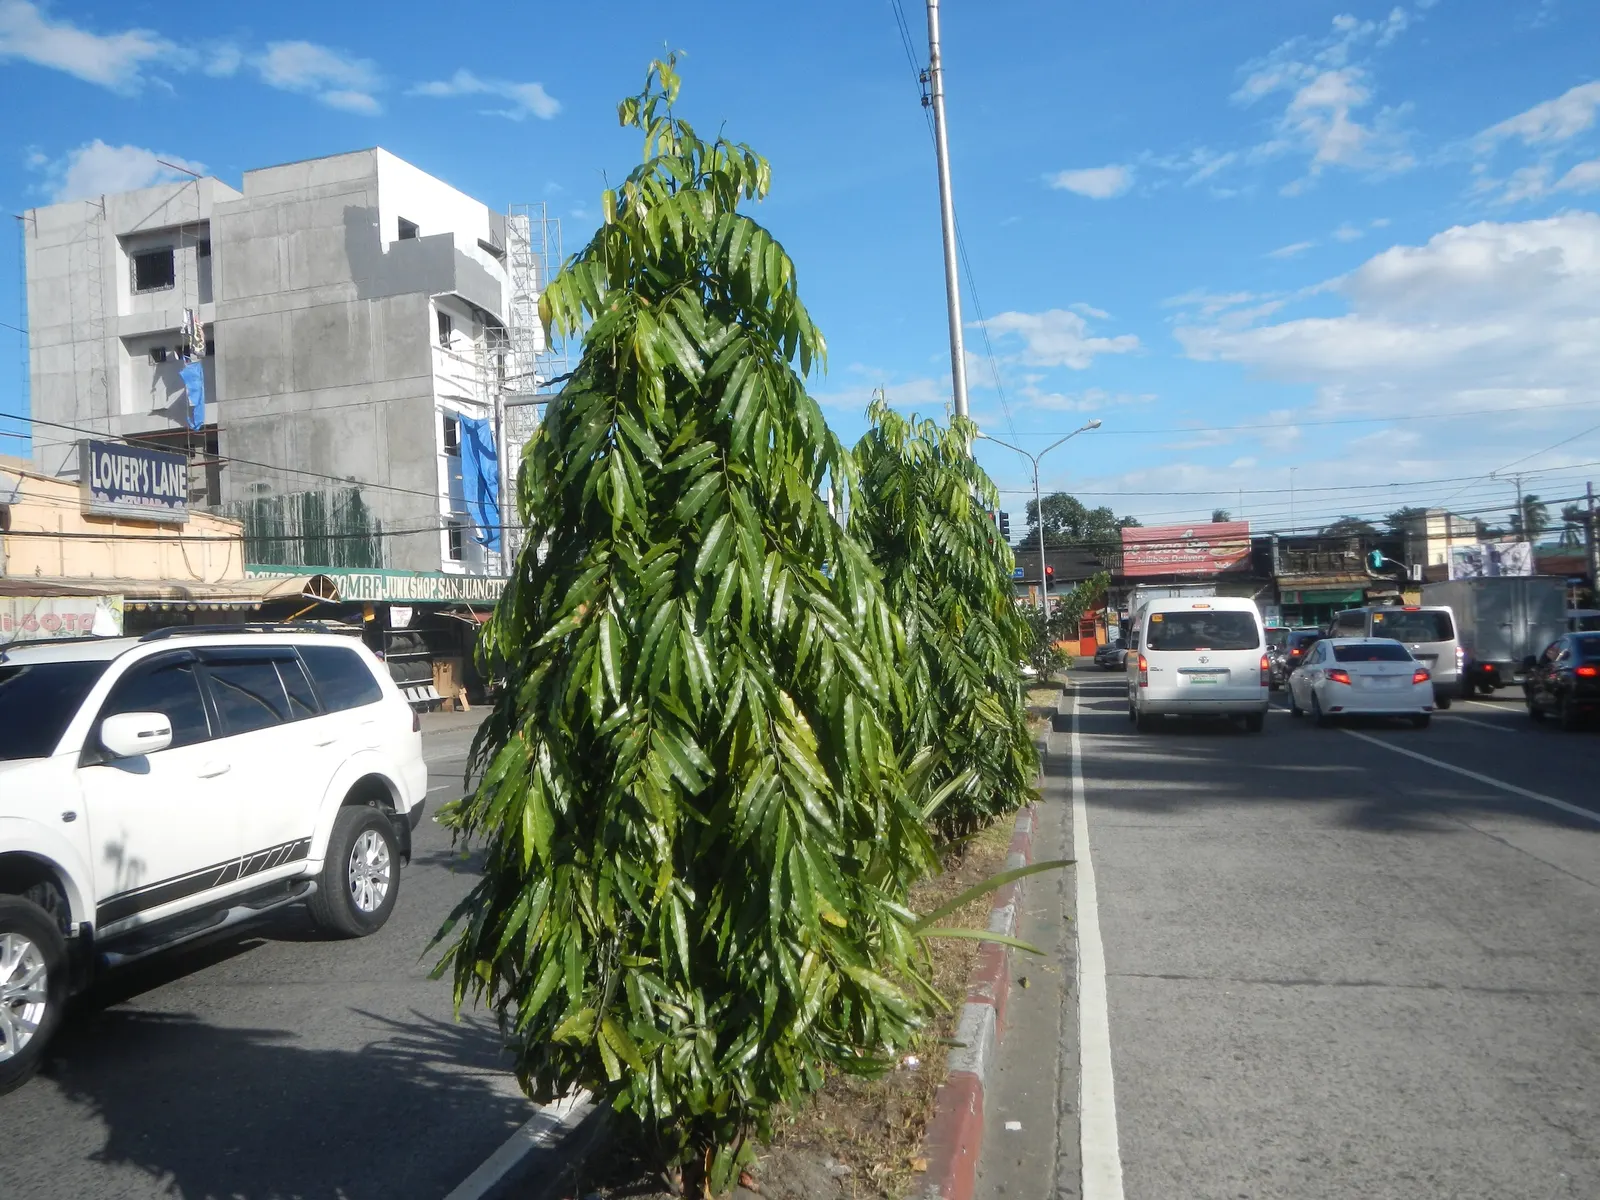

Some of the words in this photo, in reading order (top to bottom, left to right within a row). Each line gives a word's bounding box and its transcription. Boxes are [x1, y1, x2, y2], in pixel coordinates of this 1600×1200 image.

[92, 452, 149, 494] LOVER'S
[152, 461, 187, 498] LANE
[1171, 554, 1207, 562] Delivery
[348, 575, 382, 599] MRF
[0, 612, 95, 633] i-GOTO
